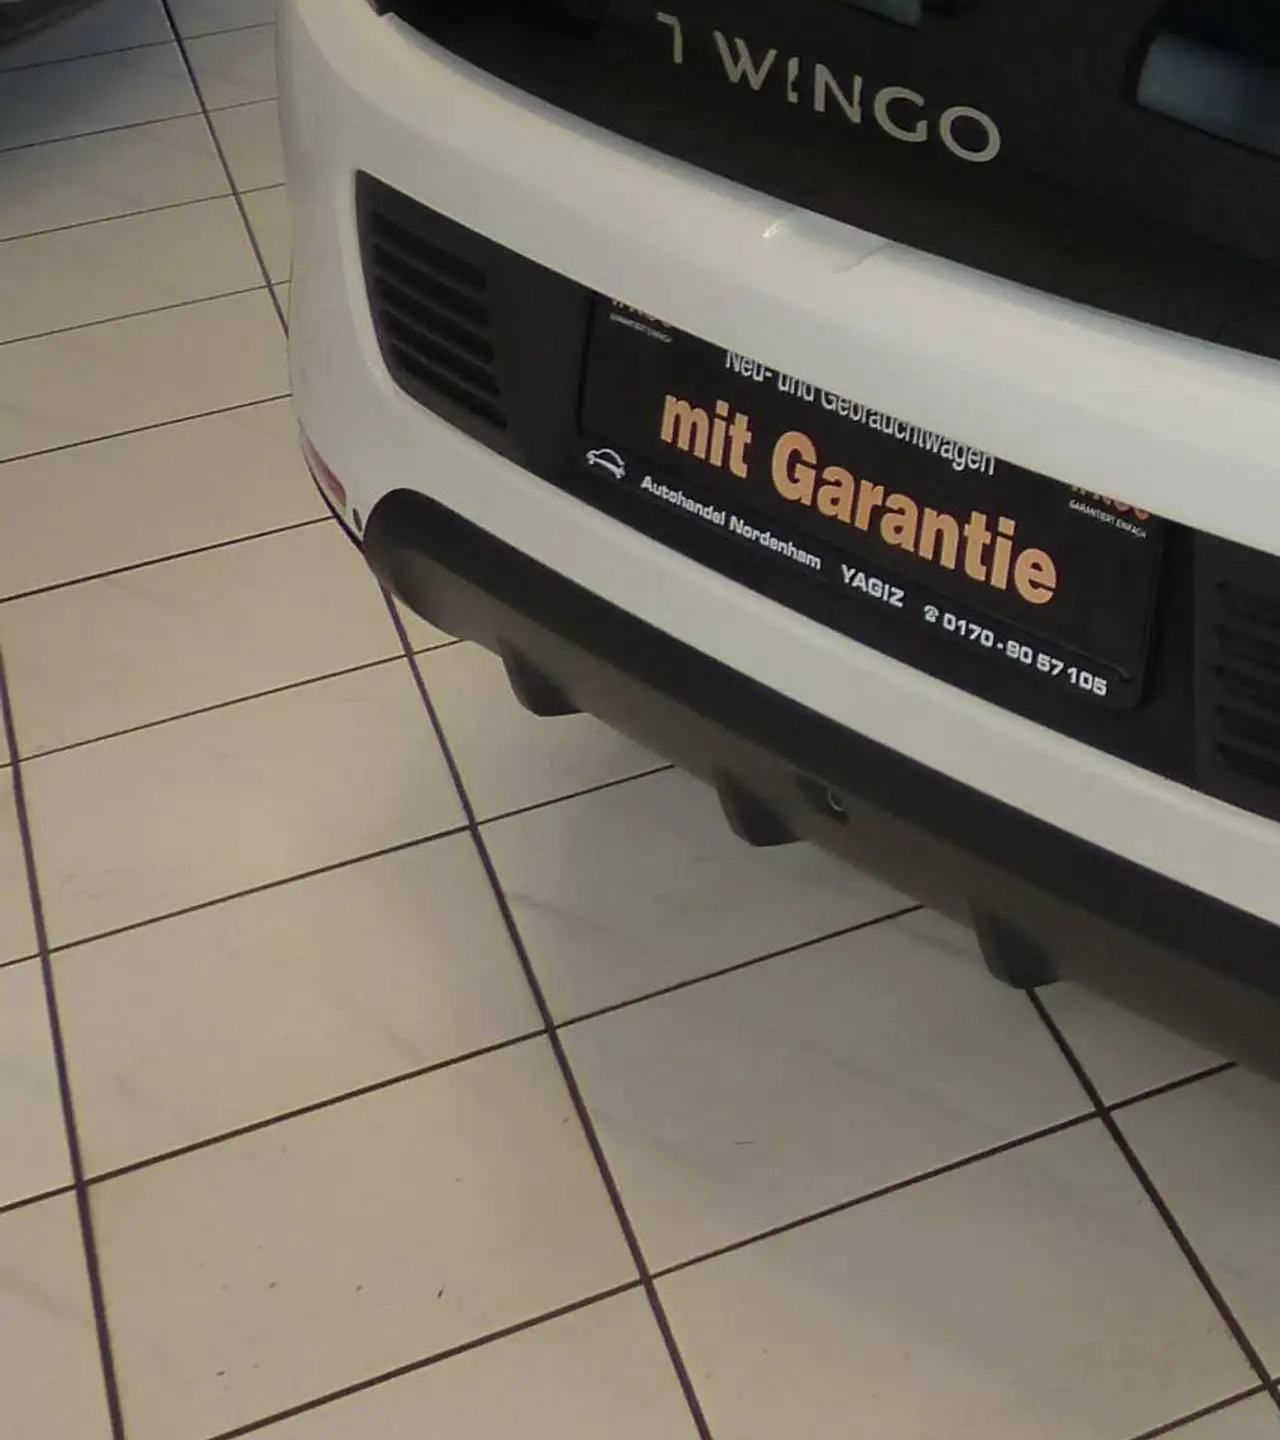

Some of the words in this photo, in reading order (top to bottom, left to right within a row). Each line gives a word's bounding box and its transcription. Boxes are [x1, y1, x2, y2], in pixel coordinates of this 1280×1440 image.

[656, 11, 1001, 162] TWINGO
[725, 350, 773, 382] Neu-
[777, 368, 815, 402] und
[640, 475, 726, 527] Autohandel
[729, 515, 822, 571] Nordenham
[840, 563, 905, 608] YAGIZ
[659, 393, 752, 479] mit
[771, 431, 1058, 606] Garantie
